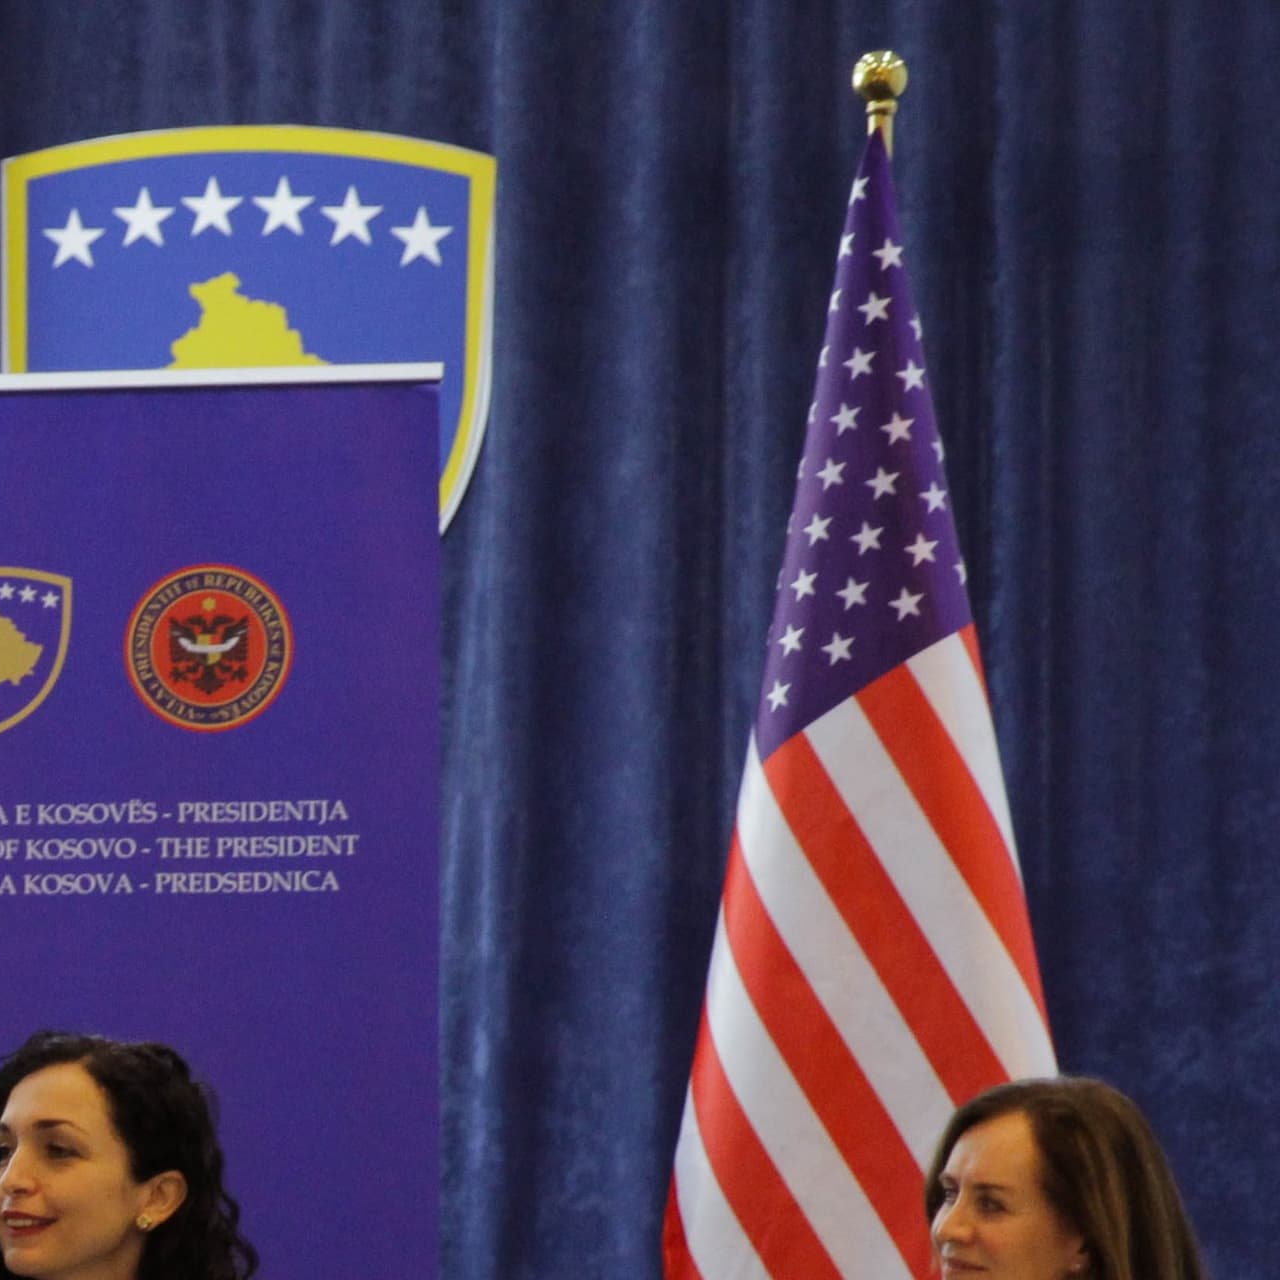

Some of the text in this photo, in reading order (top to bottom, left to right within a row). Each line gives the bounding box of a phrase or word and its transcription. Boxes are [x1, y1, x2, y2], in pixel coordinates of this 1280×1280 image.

[15, 804, 31, 825] E
[37, 799, 158, 825] KOSOVËS
[177, 799, 349, 825] PRESIDENTJA
[25, 837, 137, 860] KOSOVO
[155, 837, 210, 859] THE
[216, 834, 360, 859] PRESIDENT
[24, 873, 134, 896] KOSOVA
[155, 870, 340, 894] PREDSEDNICA
